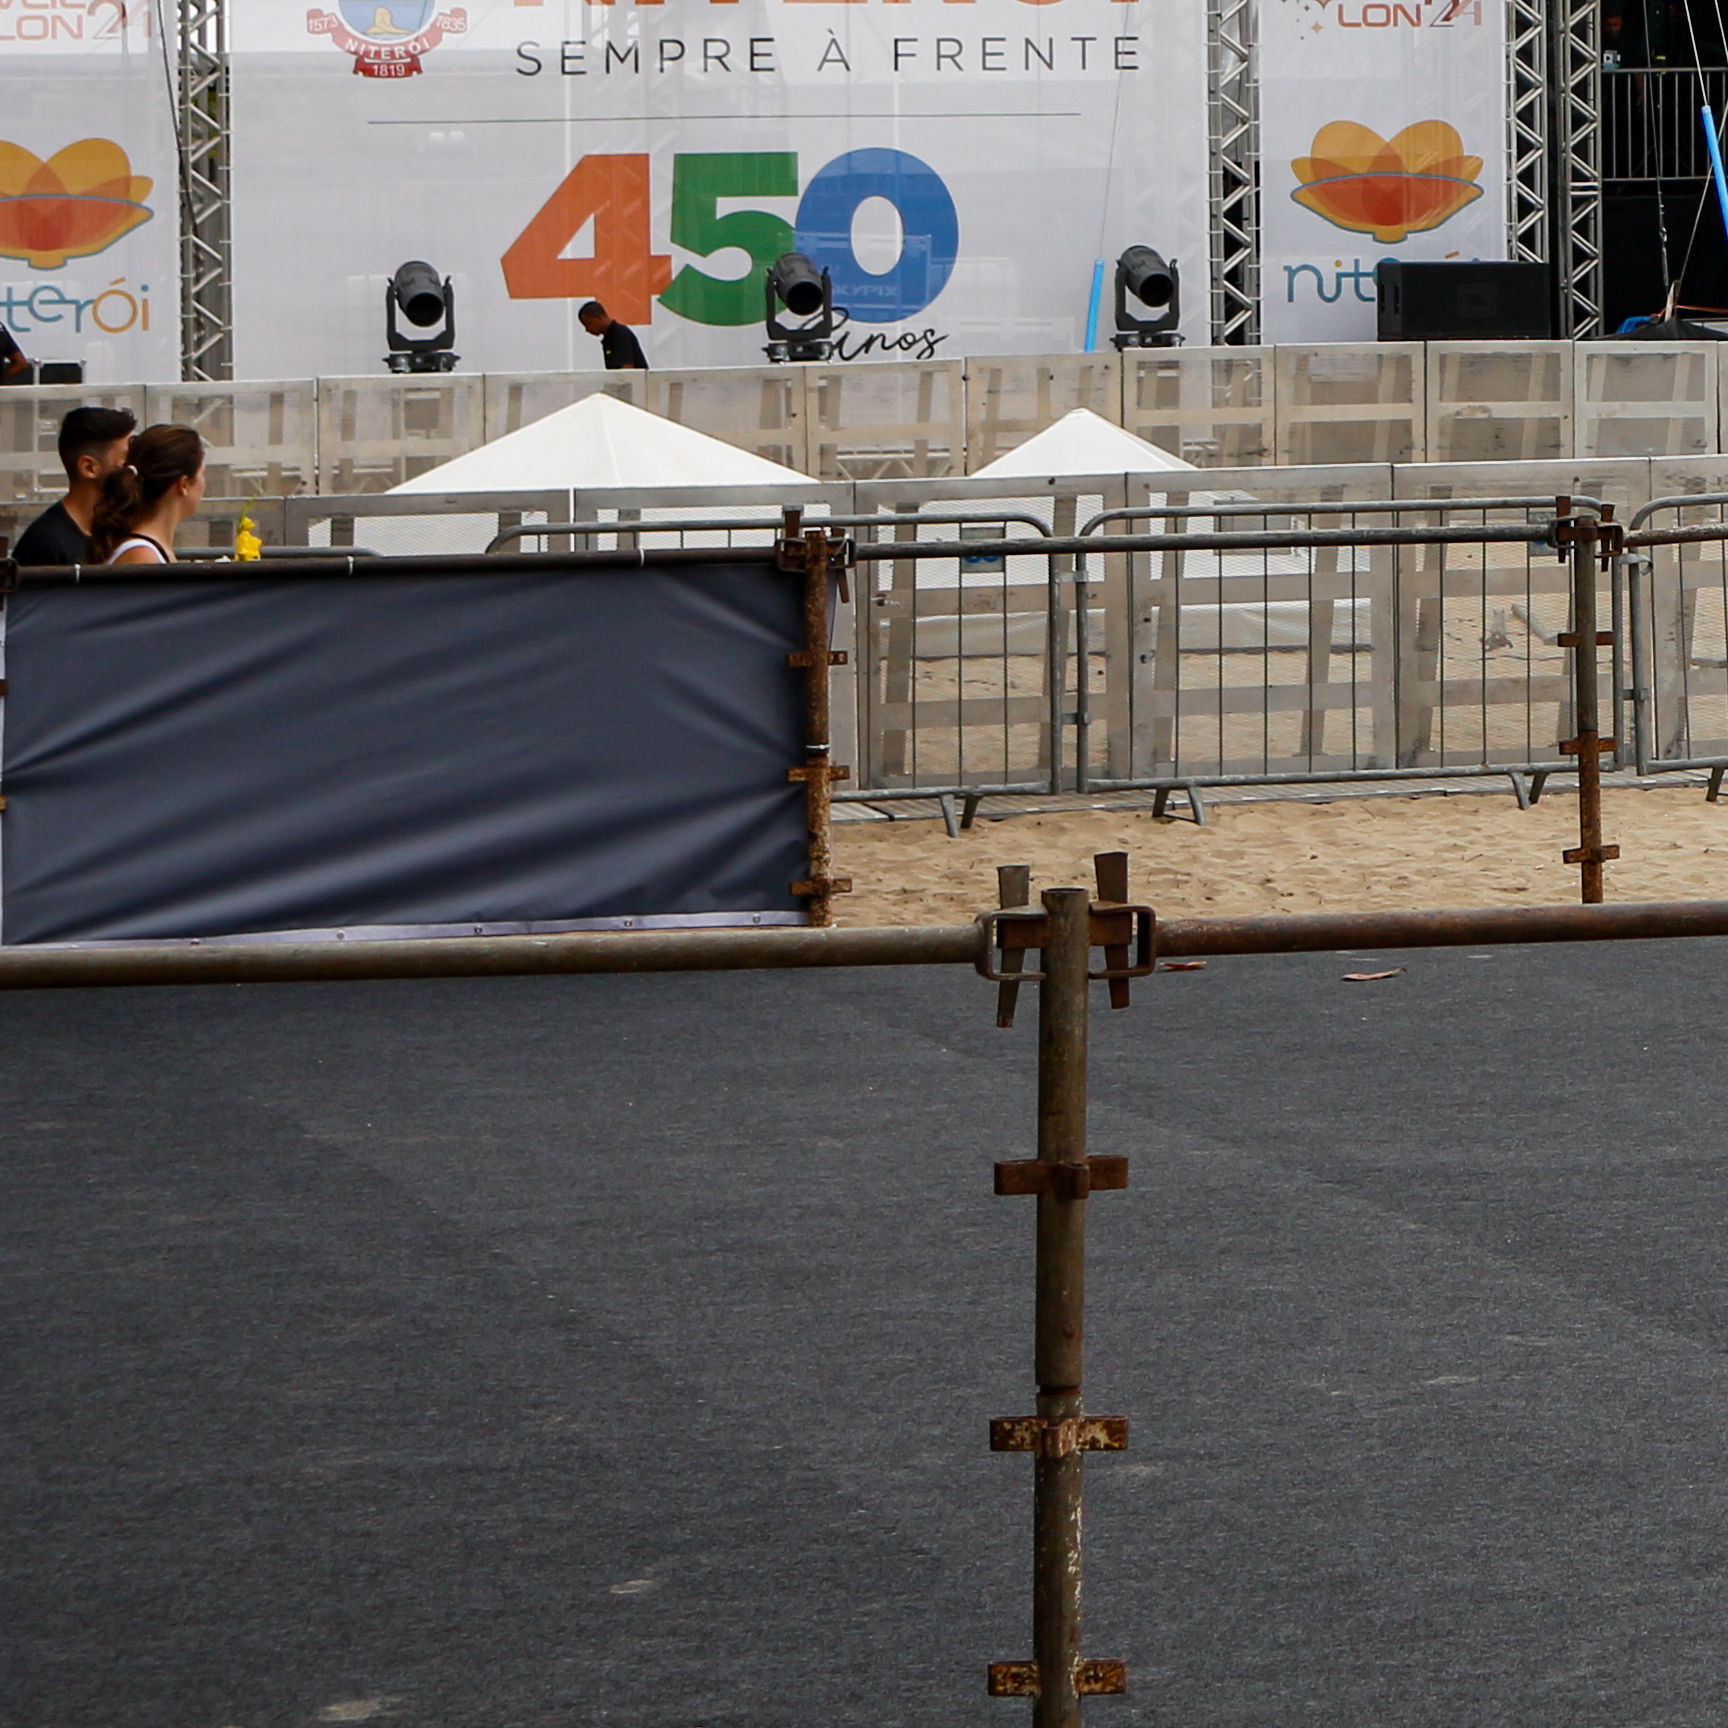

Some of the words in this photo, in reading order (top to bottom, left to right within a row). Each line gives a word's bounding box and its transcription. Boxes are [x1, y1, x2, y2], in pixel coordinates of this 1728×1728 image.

[1337, 4, 1422, 29] LON
[346, 37, 430, 60] NITERÓI
[517, 35, 777, 76] SEMPRE
[818, 26, 851, 72] À
[893, 35, 1140, 71] FRENTE
[373, 63, 406, 77] 1819
[499, 147, 960, 326] 450
